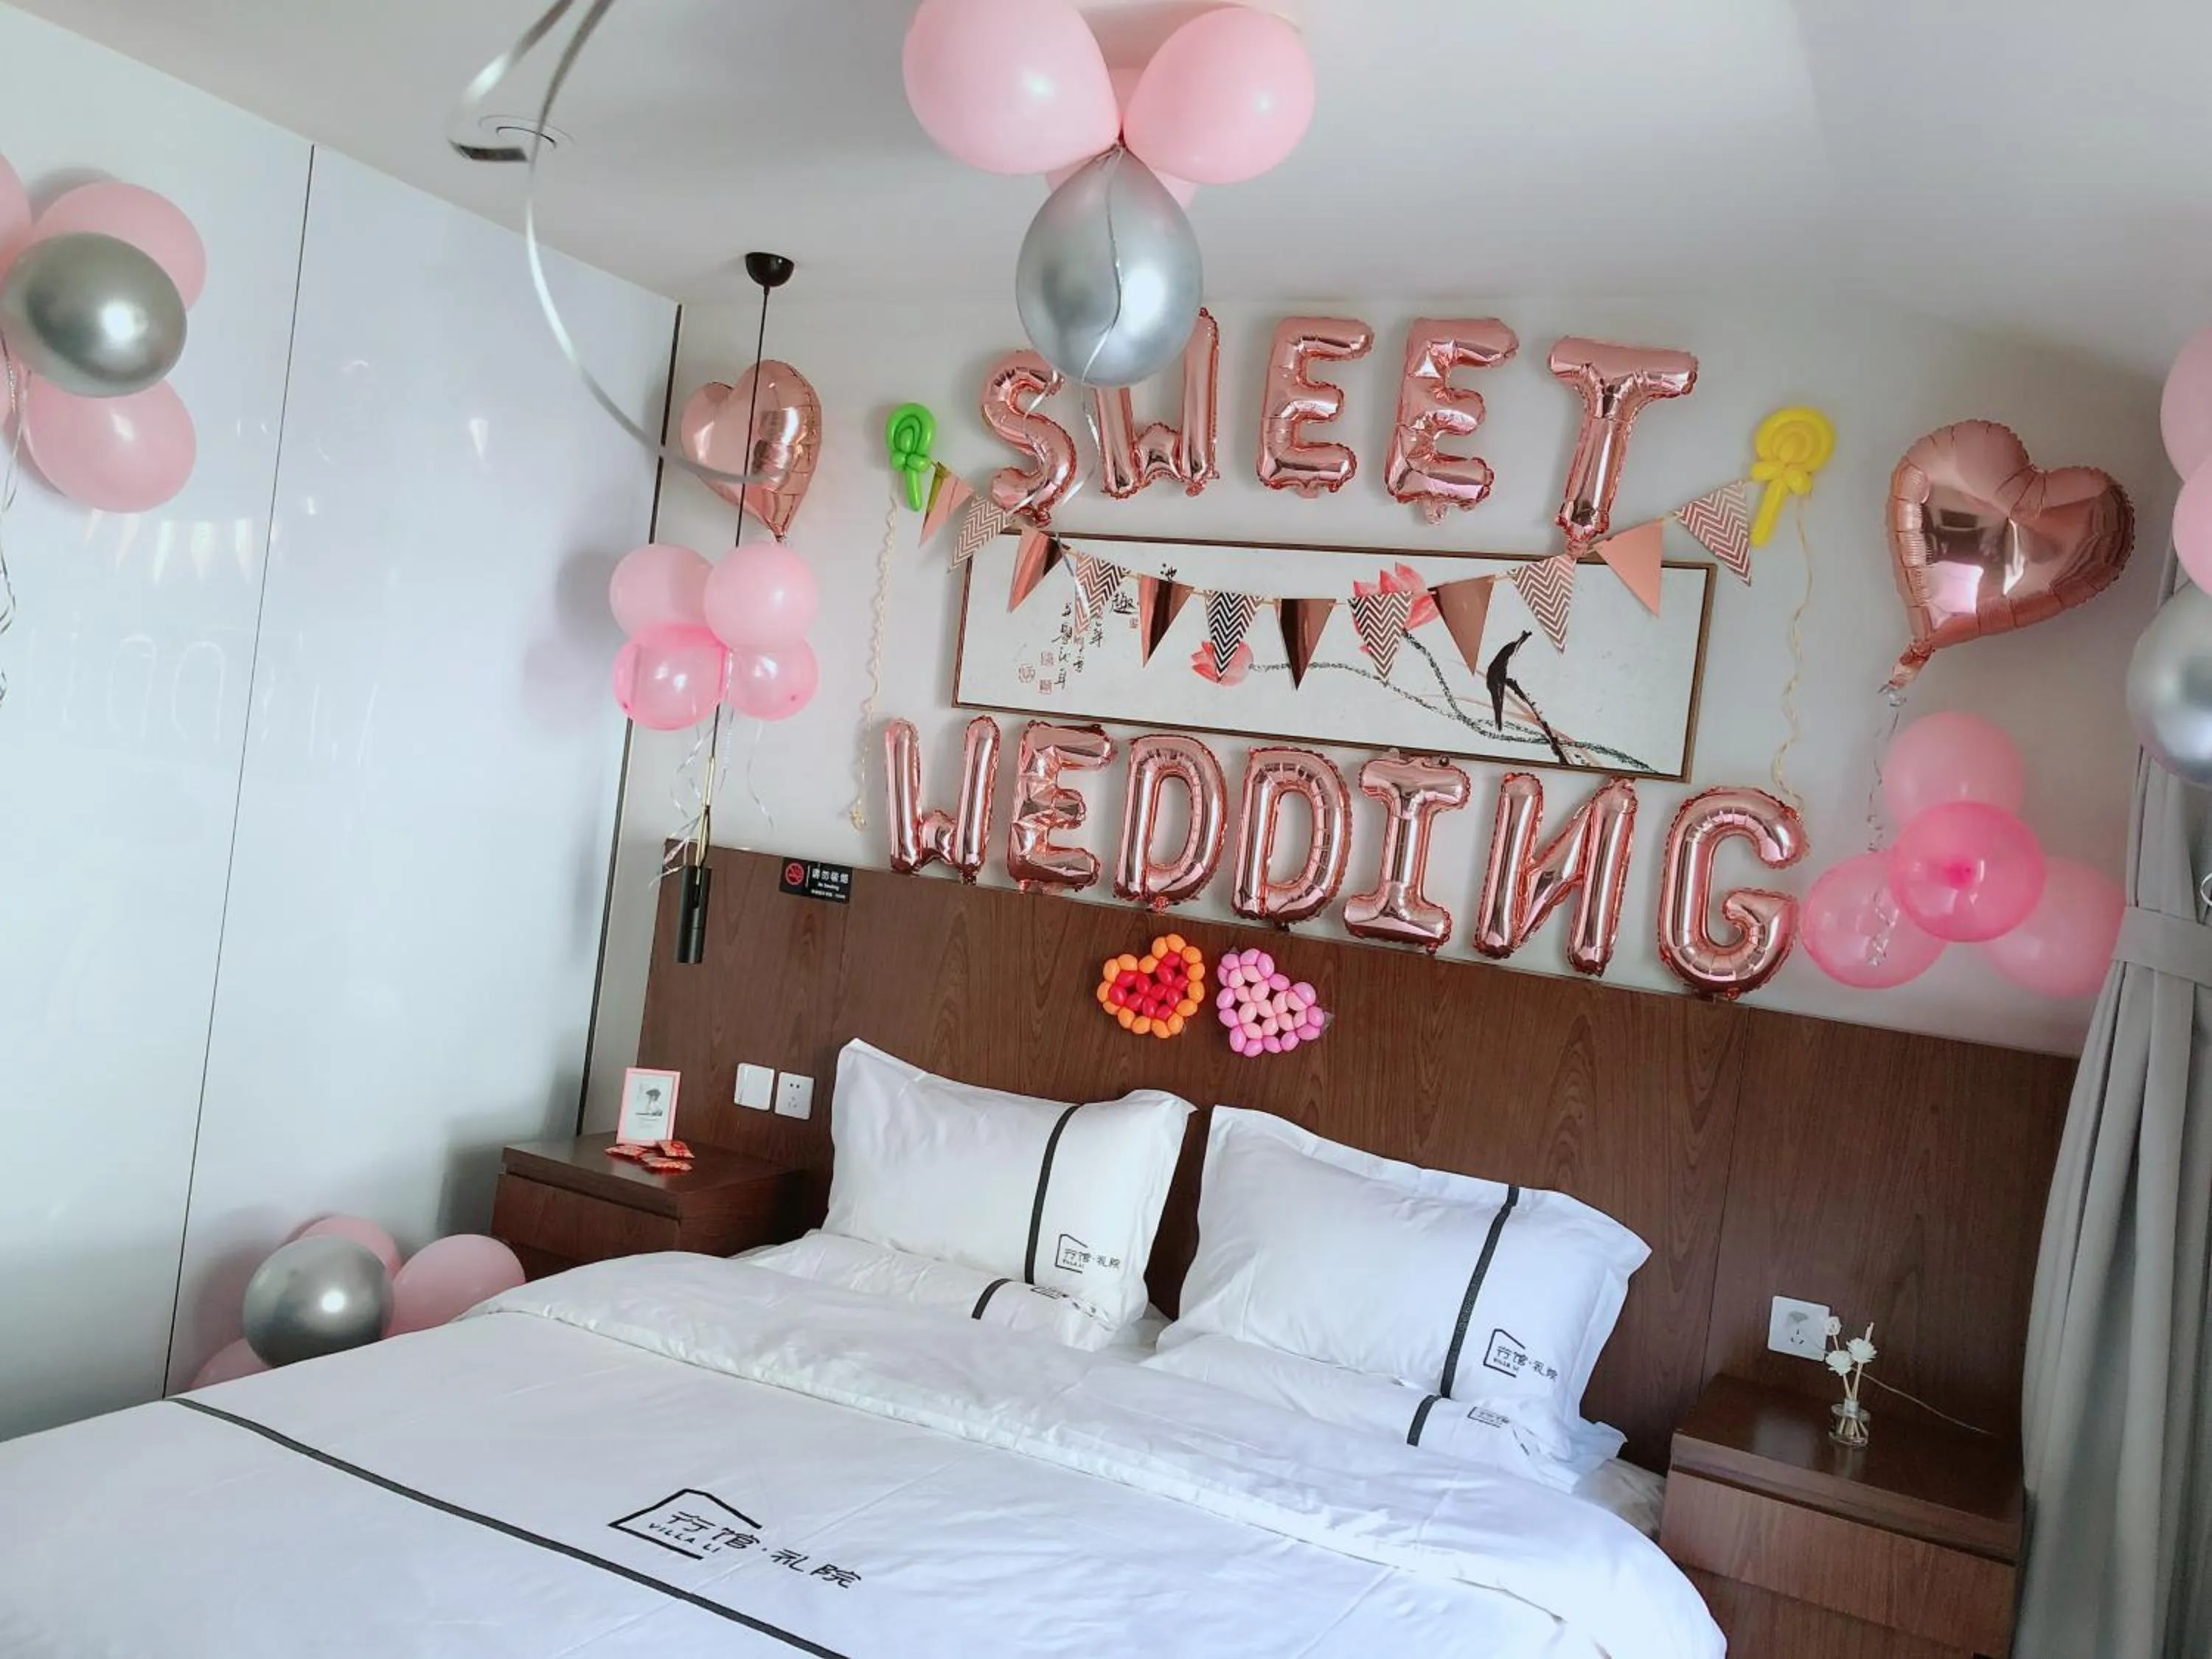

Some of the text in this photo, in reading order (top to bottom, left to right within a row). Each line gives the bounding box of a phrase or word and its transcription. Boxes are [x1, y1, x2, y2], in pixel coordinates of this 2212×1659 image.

[981, 307, 1700, 543] SWEET
[884, 715, 1812, 1000] WEDDING
[648, 1523, 722, 1554] VILLA LI
